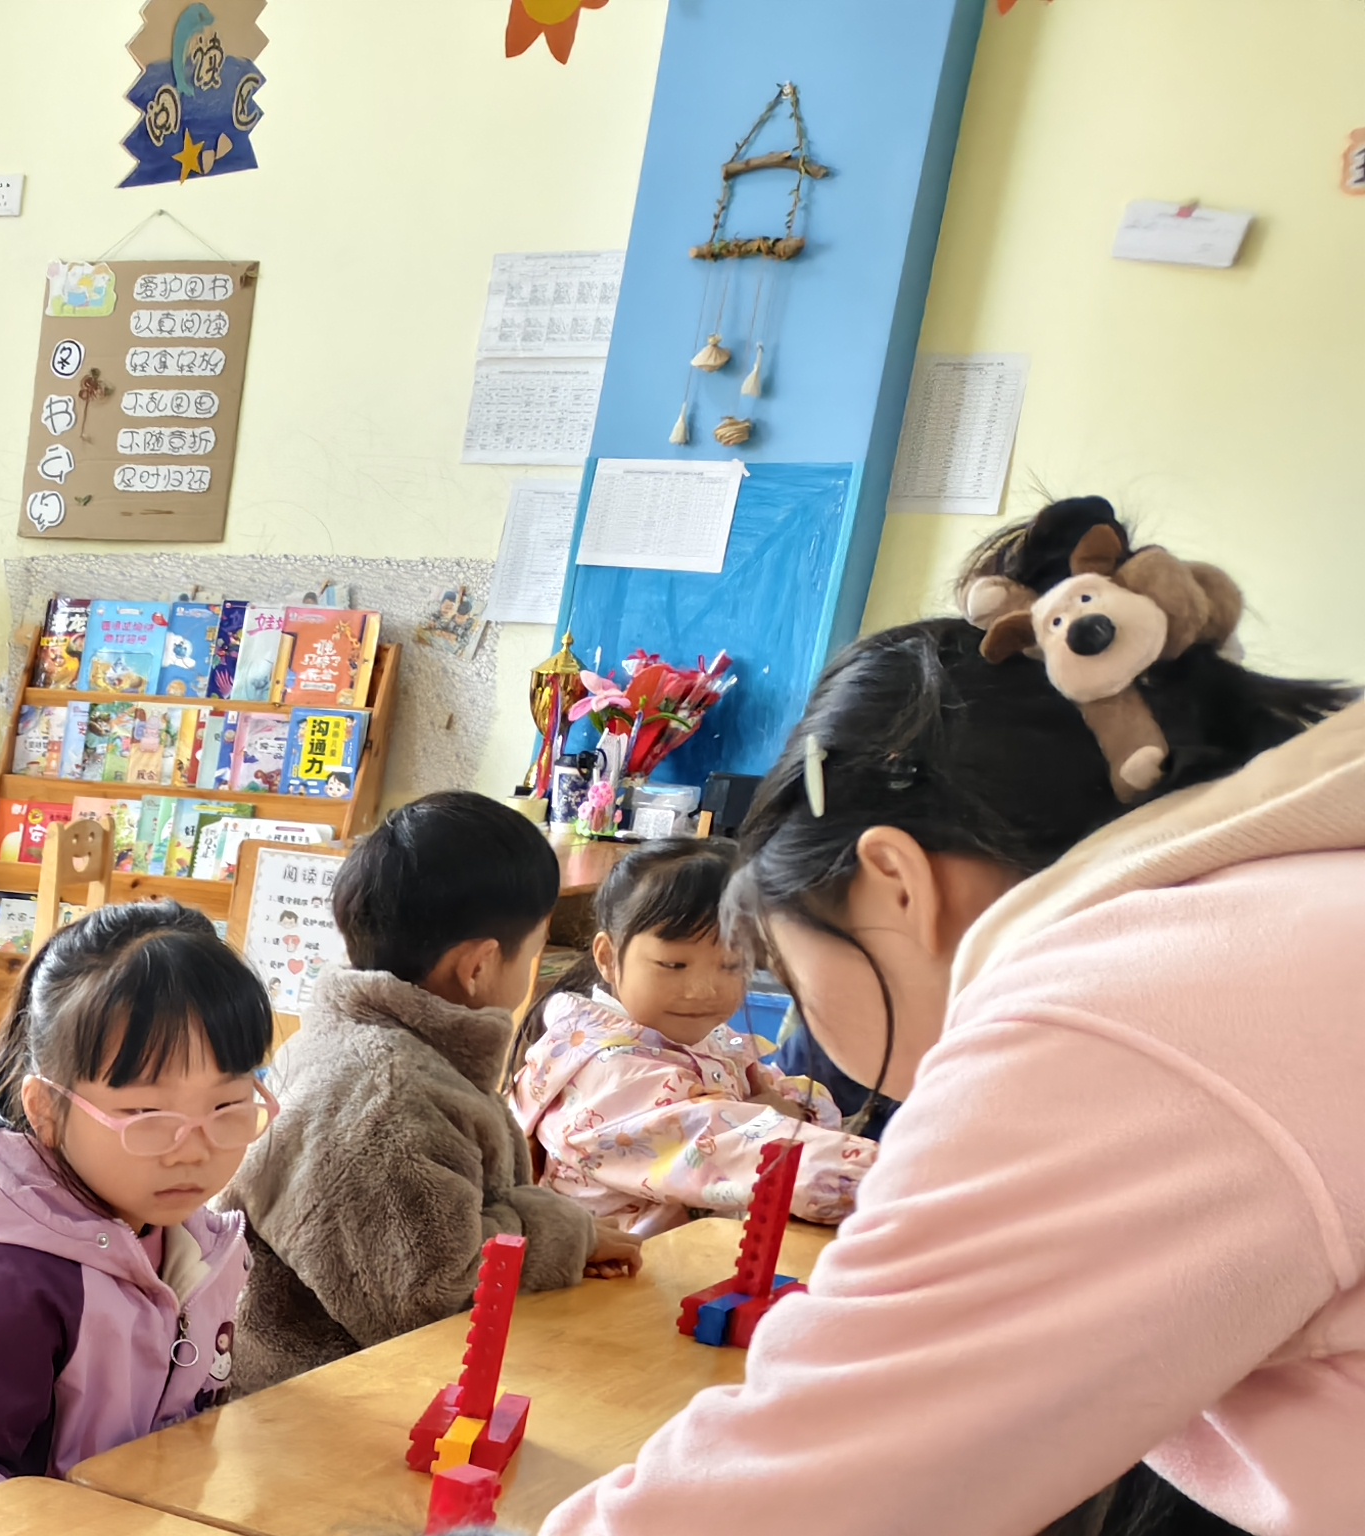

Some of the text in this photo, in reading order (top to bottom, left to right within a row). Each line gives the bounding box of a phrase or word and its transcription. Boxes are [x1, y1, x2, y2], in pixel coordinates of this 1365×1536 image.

[136, 275, 230, 299] 爱护图书
[133, 312, 227, 336] 认真阅读
[130, 349, 224, 374] 轻拿轻放
[123, 392, 215, 414] 不乱图画
[119, 430, 212, 453] 不随意折
[117, 466, 210, 490] 及时归还
[304, 719, 329, 774] 沟通力
